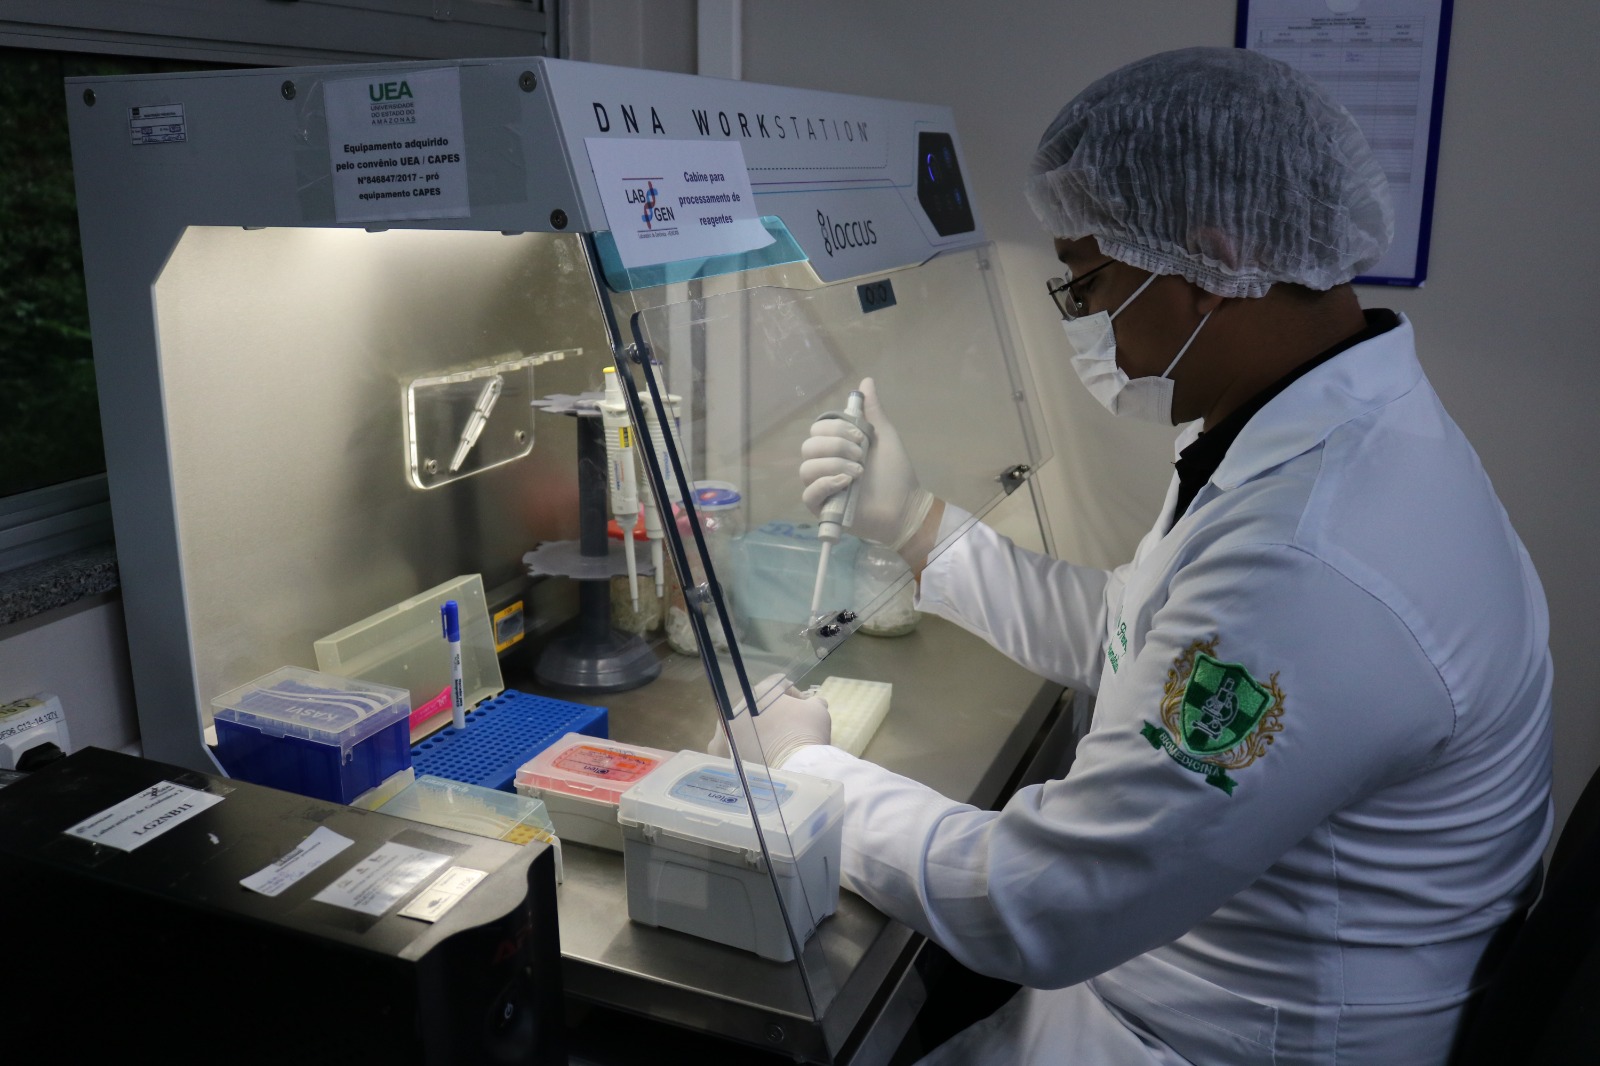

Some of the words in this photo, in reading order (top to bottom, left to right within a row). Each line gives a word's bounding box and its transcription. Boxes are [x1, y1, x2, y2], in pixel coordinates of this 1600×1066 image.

[369, 81, 413, 102] UEA
[371, 102, 414, 112] UNIVERSIDADE
[371, 116, 416, 126] AMAZONAS
[593, 102, 666, 135] DNA
[692, 109, 868, 142] WORKSTATION
[343, 141, 402, 154] Equipamento
[405, 137, 449, 150] adquirido
[336, 162, 355, 172] pelo
[357, 158, 398, 169] convênio
[400, 157, 420, 166] UEA
[428, 154, 460, 165] CAPES
[684, 171, 708, 183] Cabine
[709, 173, 725, 184] para
[359, 190, 411, 200] equipamento
[413, 188, 441, 197] CAPES
[625, 188, 646, 204] LAB
[679, 194, 730, 208] processamento
[732, 192, 741, 202] de
[654, 207, 676, 221] GEN
[700, 214, 734, 227] reagentes
[286, 705, 339, 721] KASVI
[1159, 731, 1220, 777] BIOMEDICINA
[132, 803, 194, 837] LG2NB11
